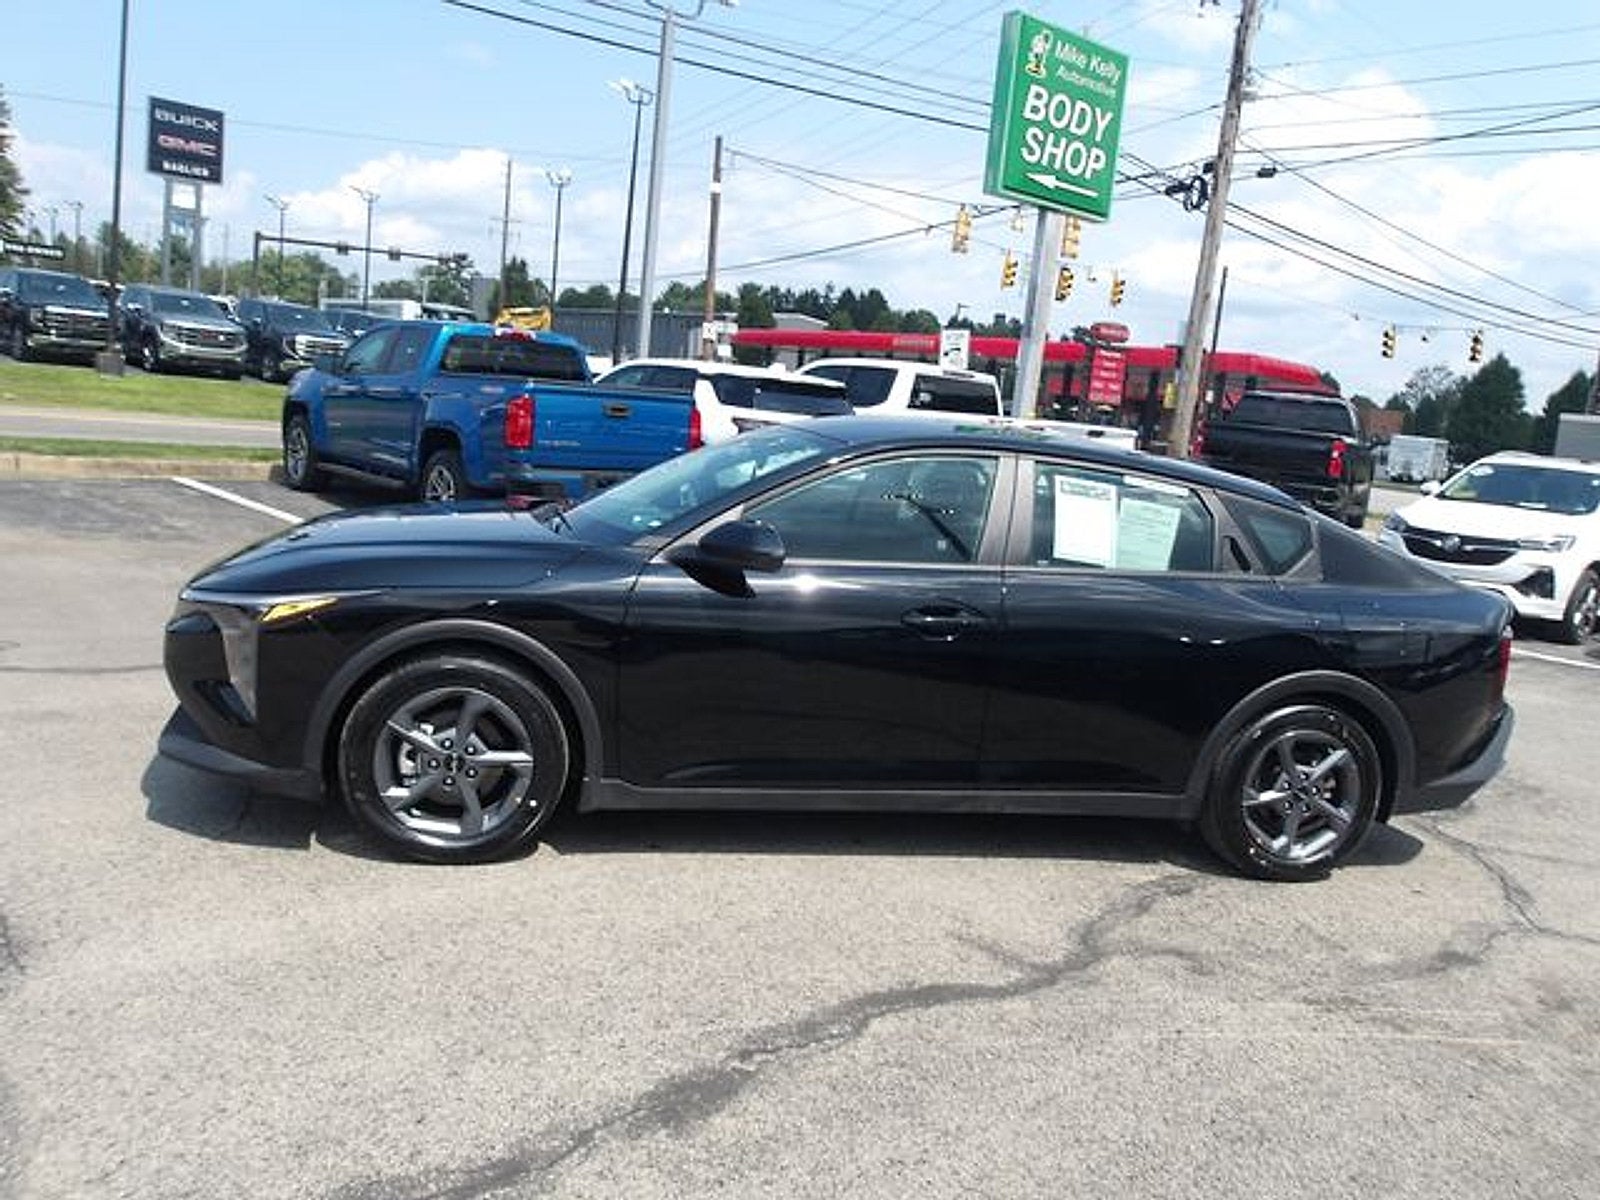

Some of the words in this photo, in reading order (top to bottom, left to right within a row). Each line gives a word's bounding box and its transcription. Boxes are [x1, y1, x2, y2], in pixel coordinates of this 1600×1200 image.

[1055, 40, 1087, 69] Mike
[1090, 54, 1121, 85] Kelly
[1056, 65, 1117, 98] Automotive
[154, 107, 219, 132] BUICK
[1022, 84, 1113, 142] BODY
[158, 134, 217, 156] GMC
[1021, 127, 1107, 180] SHOP
